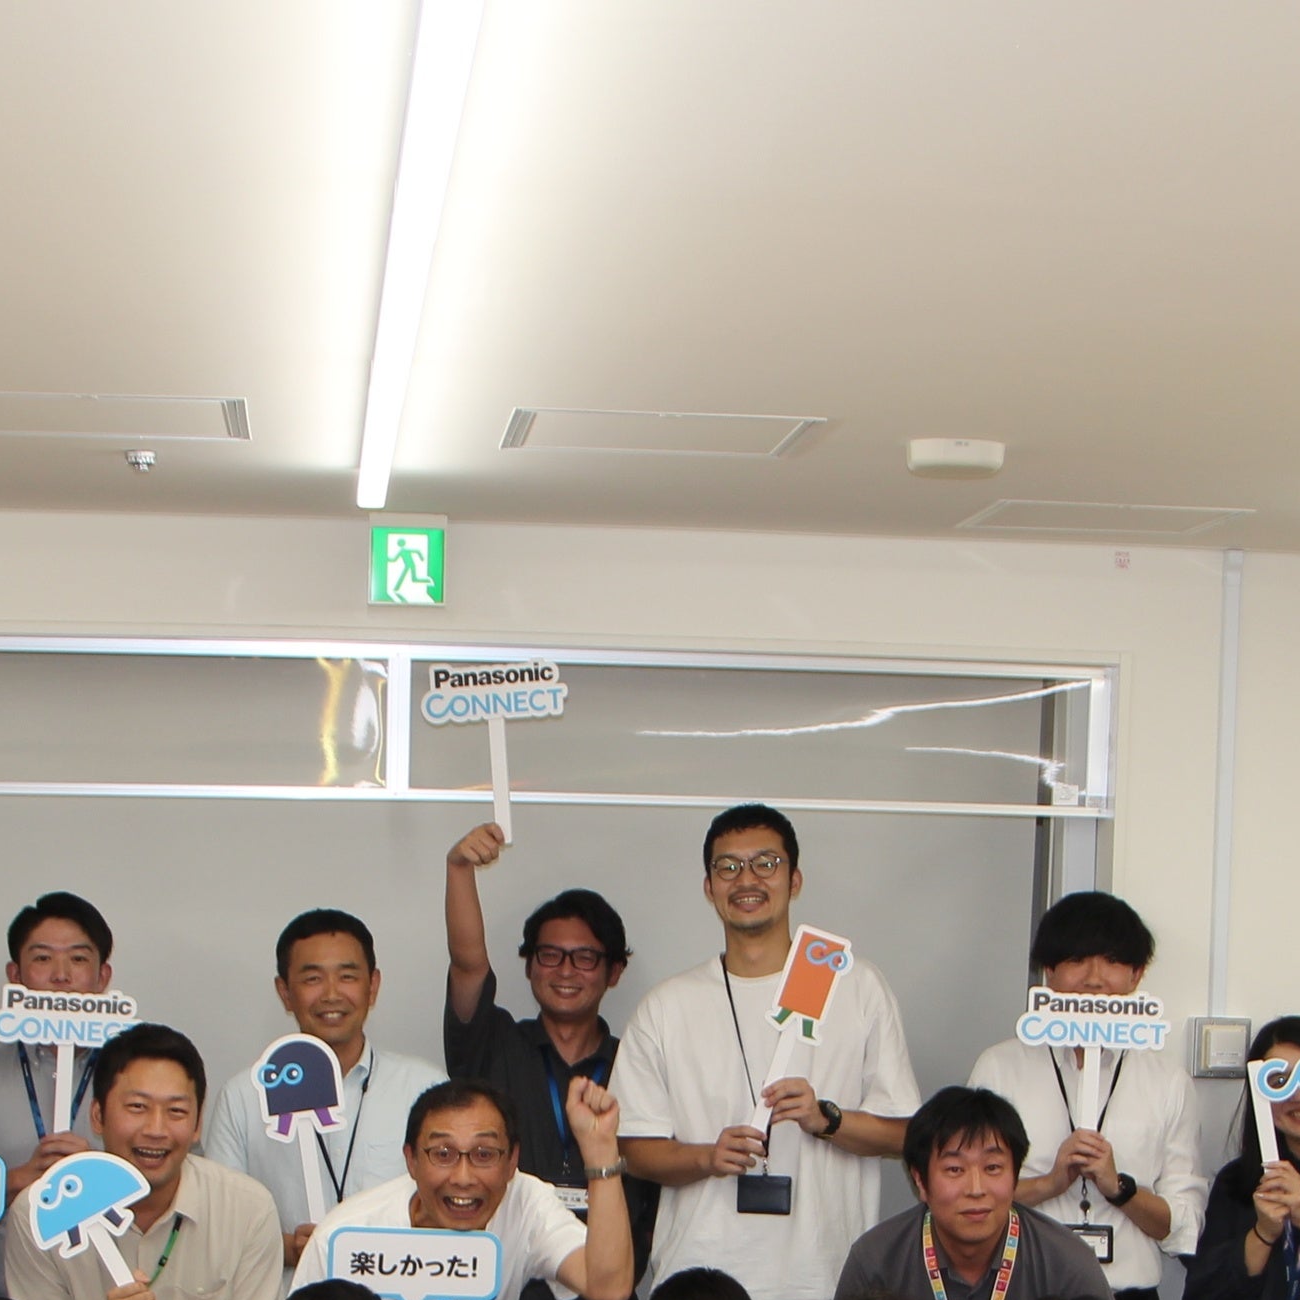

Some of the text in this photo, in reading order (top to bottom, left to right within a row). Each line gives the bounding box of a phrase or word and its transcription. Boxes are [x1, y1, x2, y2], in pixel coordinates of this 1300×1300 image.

[434, 662, 554, 688] Panasonic
[425, 688, 562, 718] CONNECT
[7, 989, 132, 1015] Panasonic
[1033, 992, 1159, 1016] Panasonic
[1021, 1016, 1166, 1045] CONNECT
[350, 1251, 478, 1278] 楽しかった!
